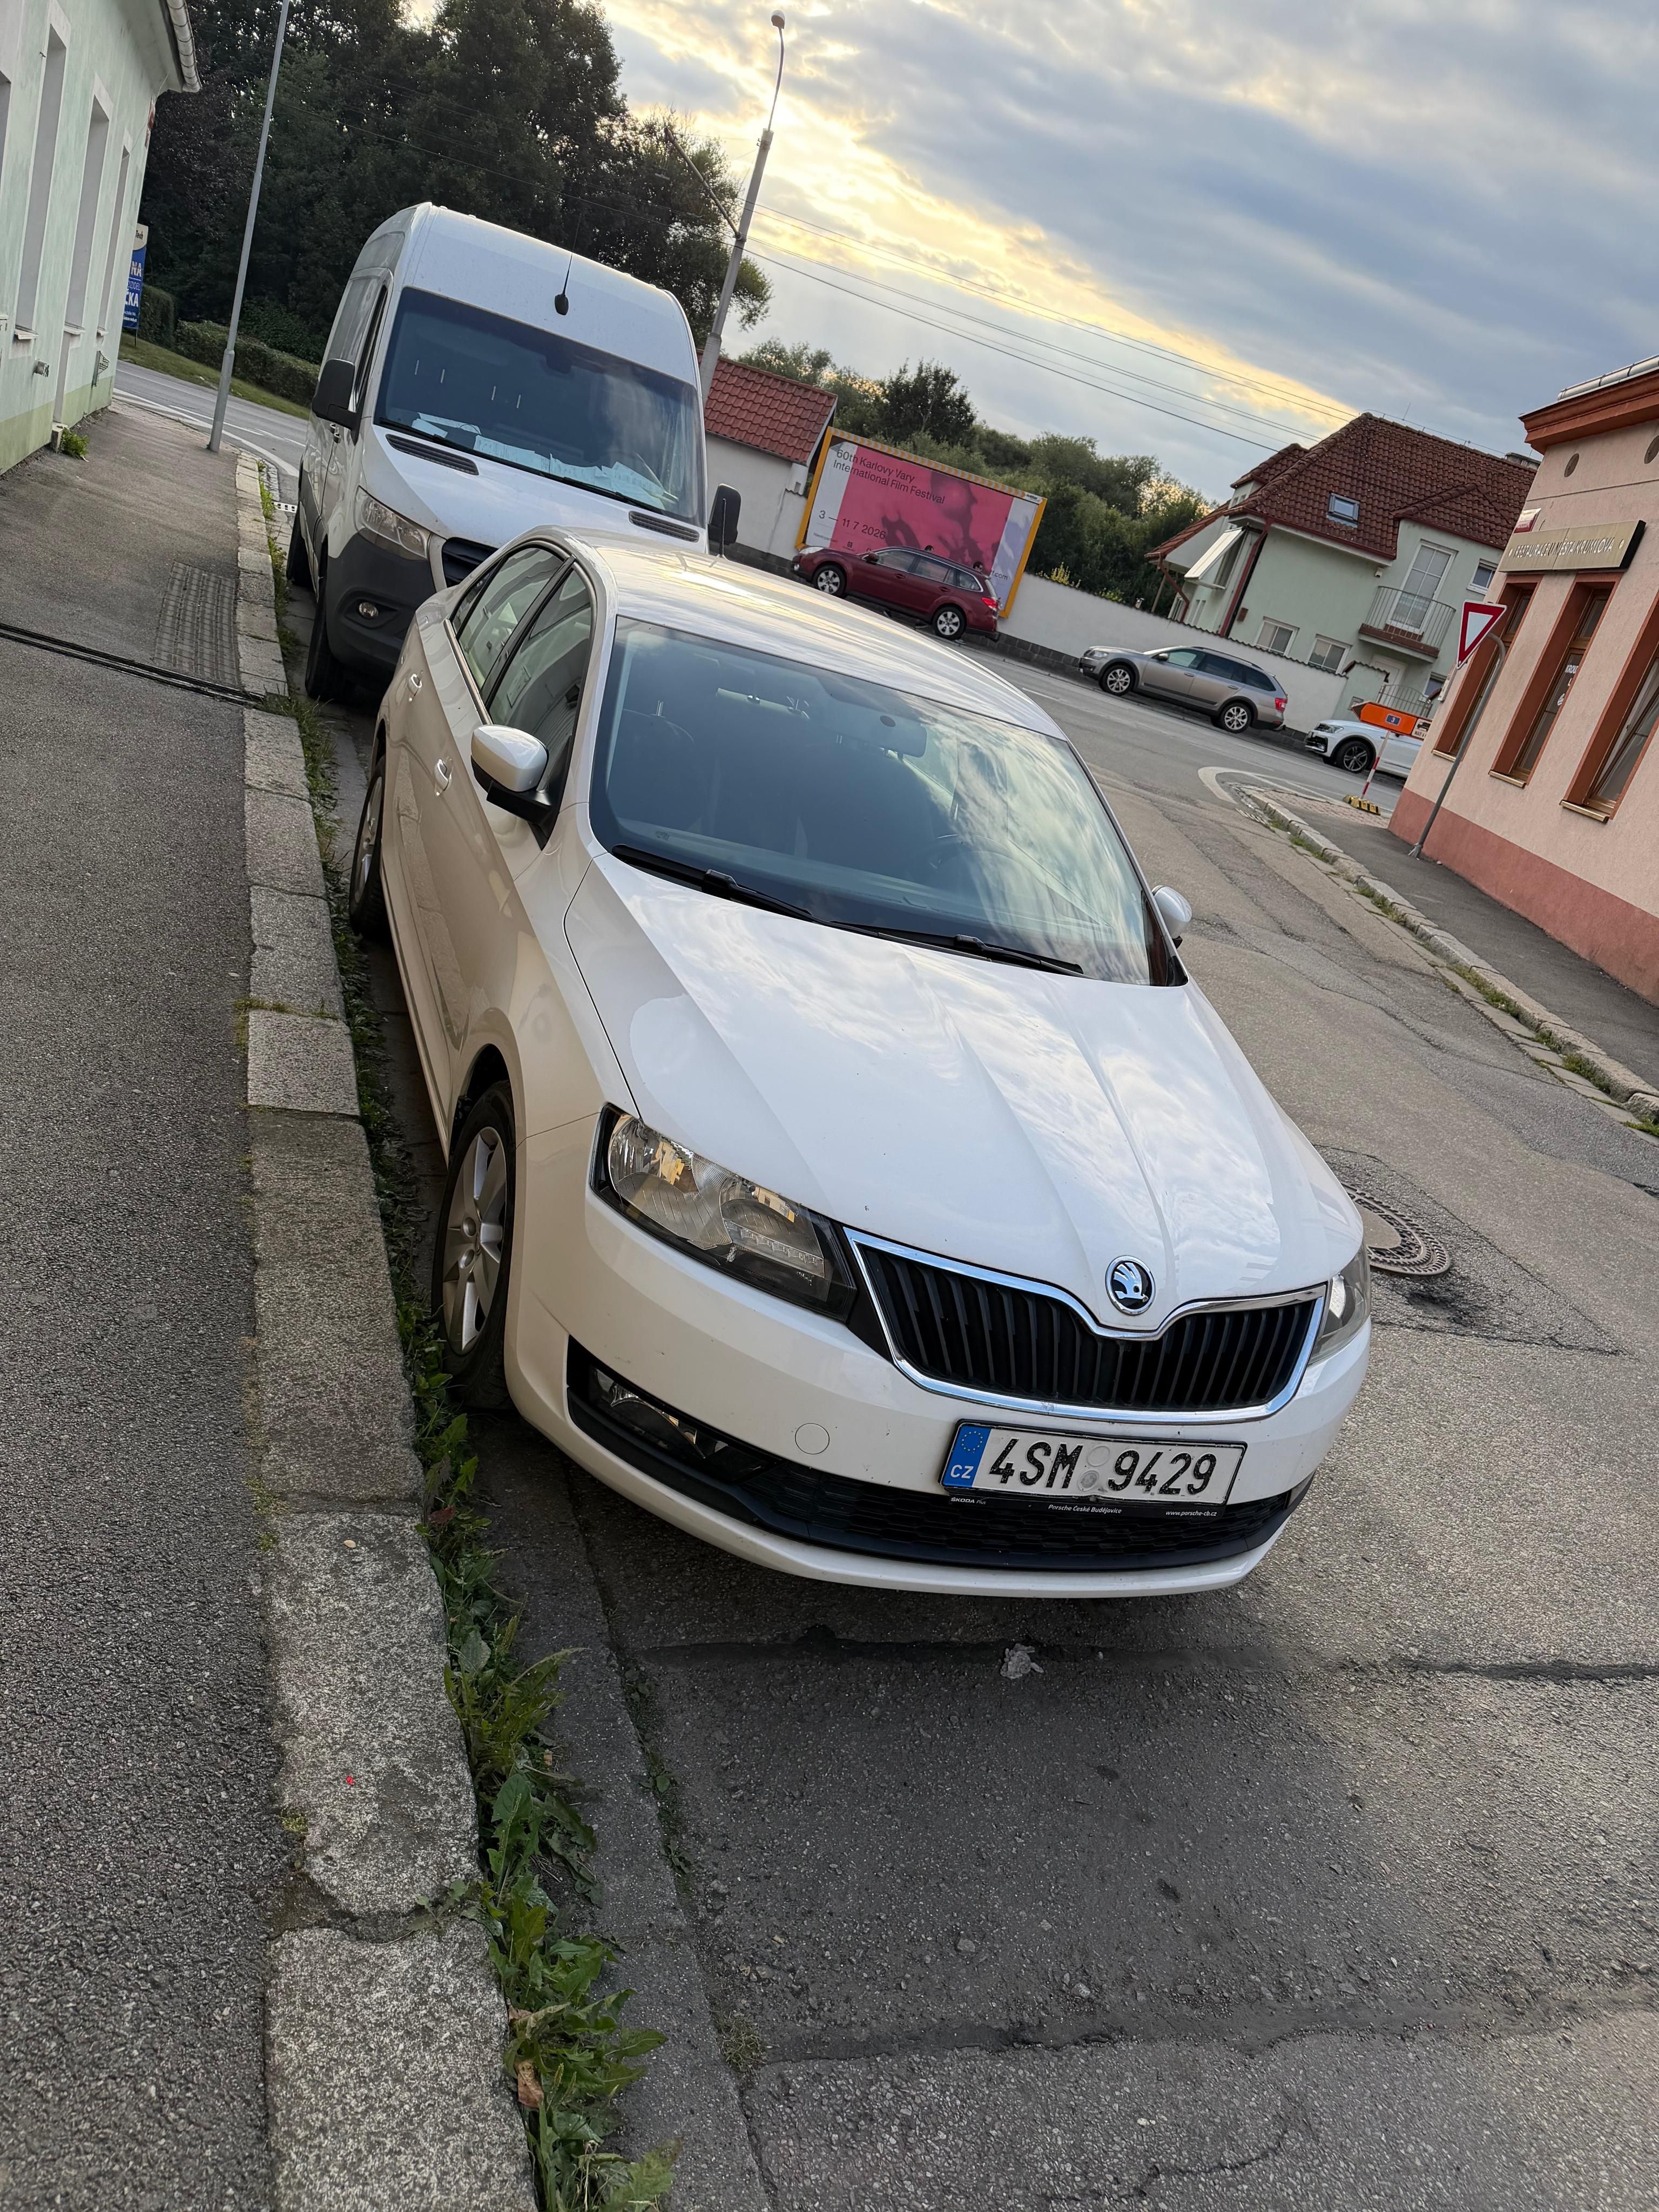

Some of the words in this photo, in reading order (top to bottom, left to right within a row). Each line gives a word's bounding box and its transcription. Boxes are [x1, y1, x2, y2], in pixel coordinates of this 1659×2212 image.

[833, 460, 890, 485] International
[891, 480, 909, 492] Film
[910, 485, 945, 504] Festival
[837, 449, 858, 463] 60th
[860, 457, 894, 476] Karlovy
[895, 469, 915, 484] Vary
[819, 510, 826, 519] 3
[842, 518, 851, 528] 11
[853, 521, 859, 530] 7
[861, 524, 886, 539] 2026
[950, 1464, 974, 1479] CZ
[989, 1438, 1083, 1489] 4SM
[1108, 1450, 1217, 1495] 9429
